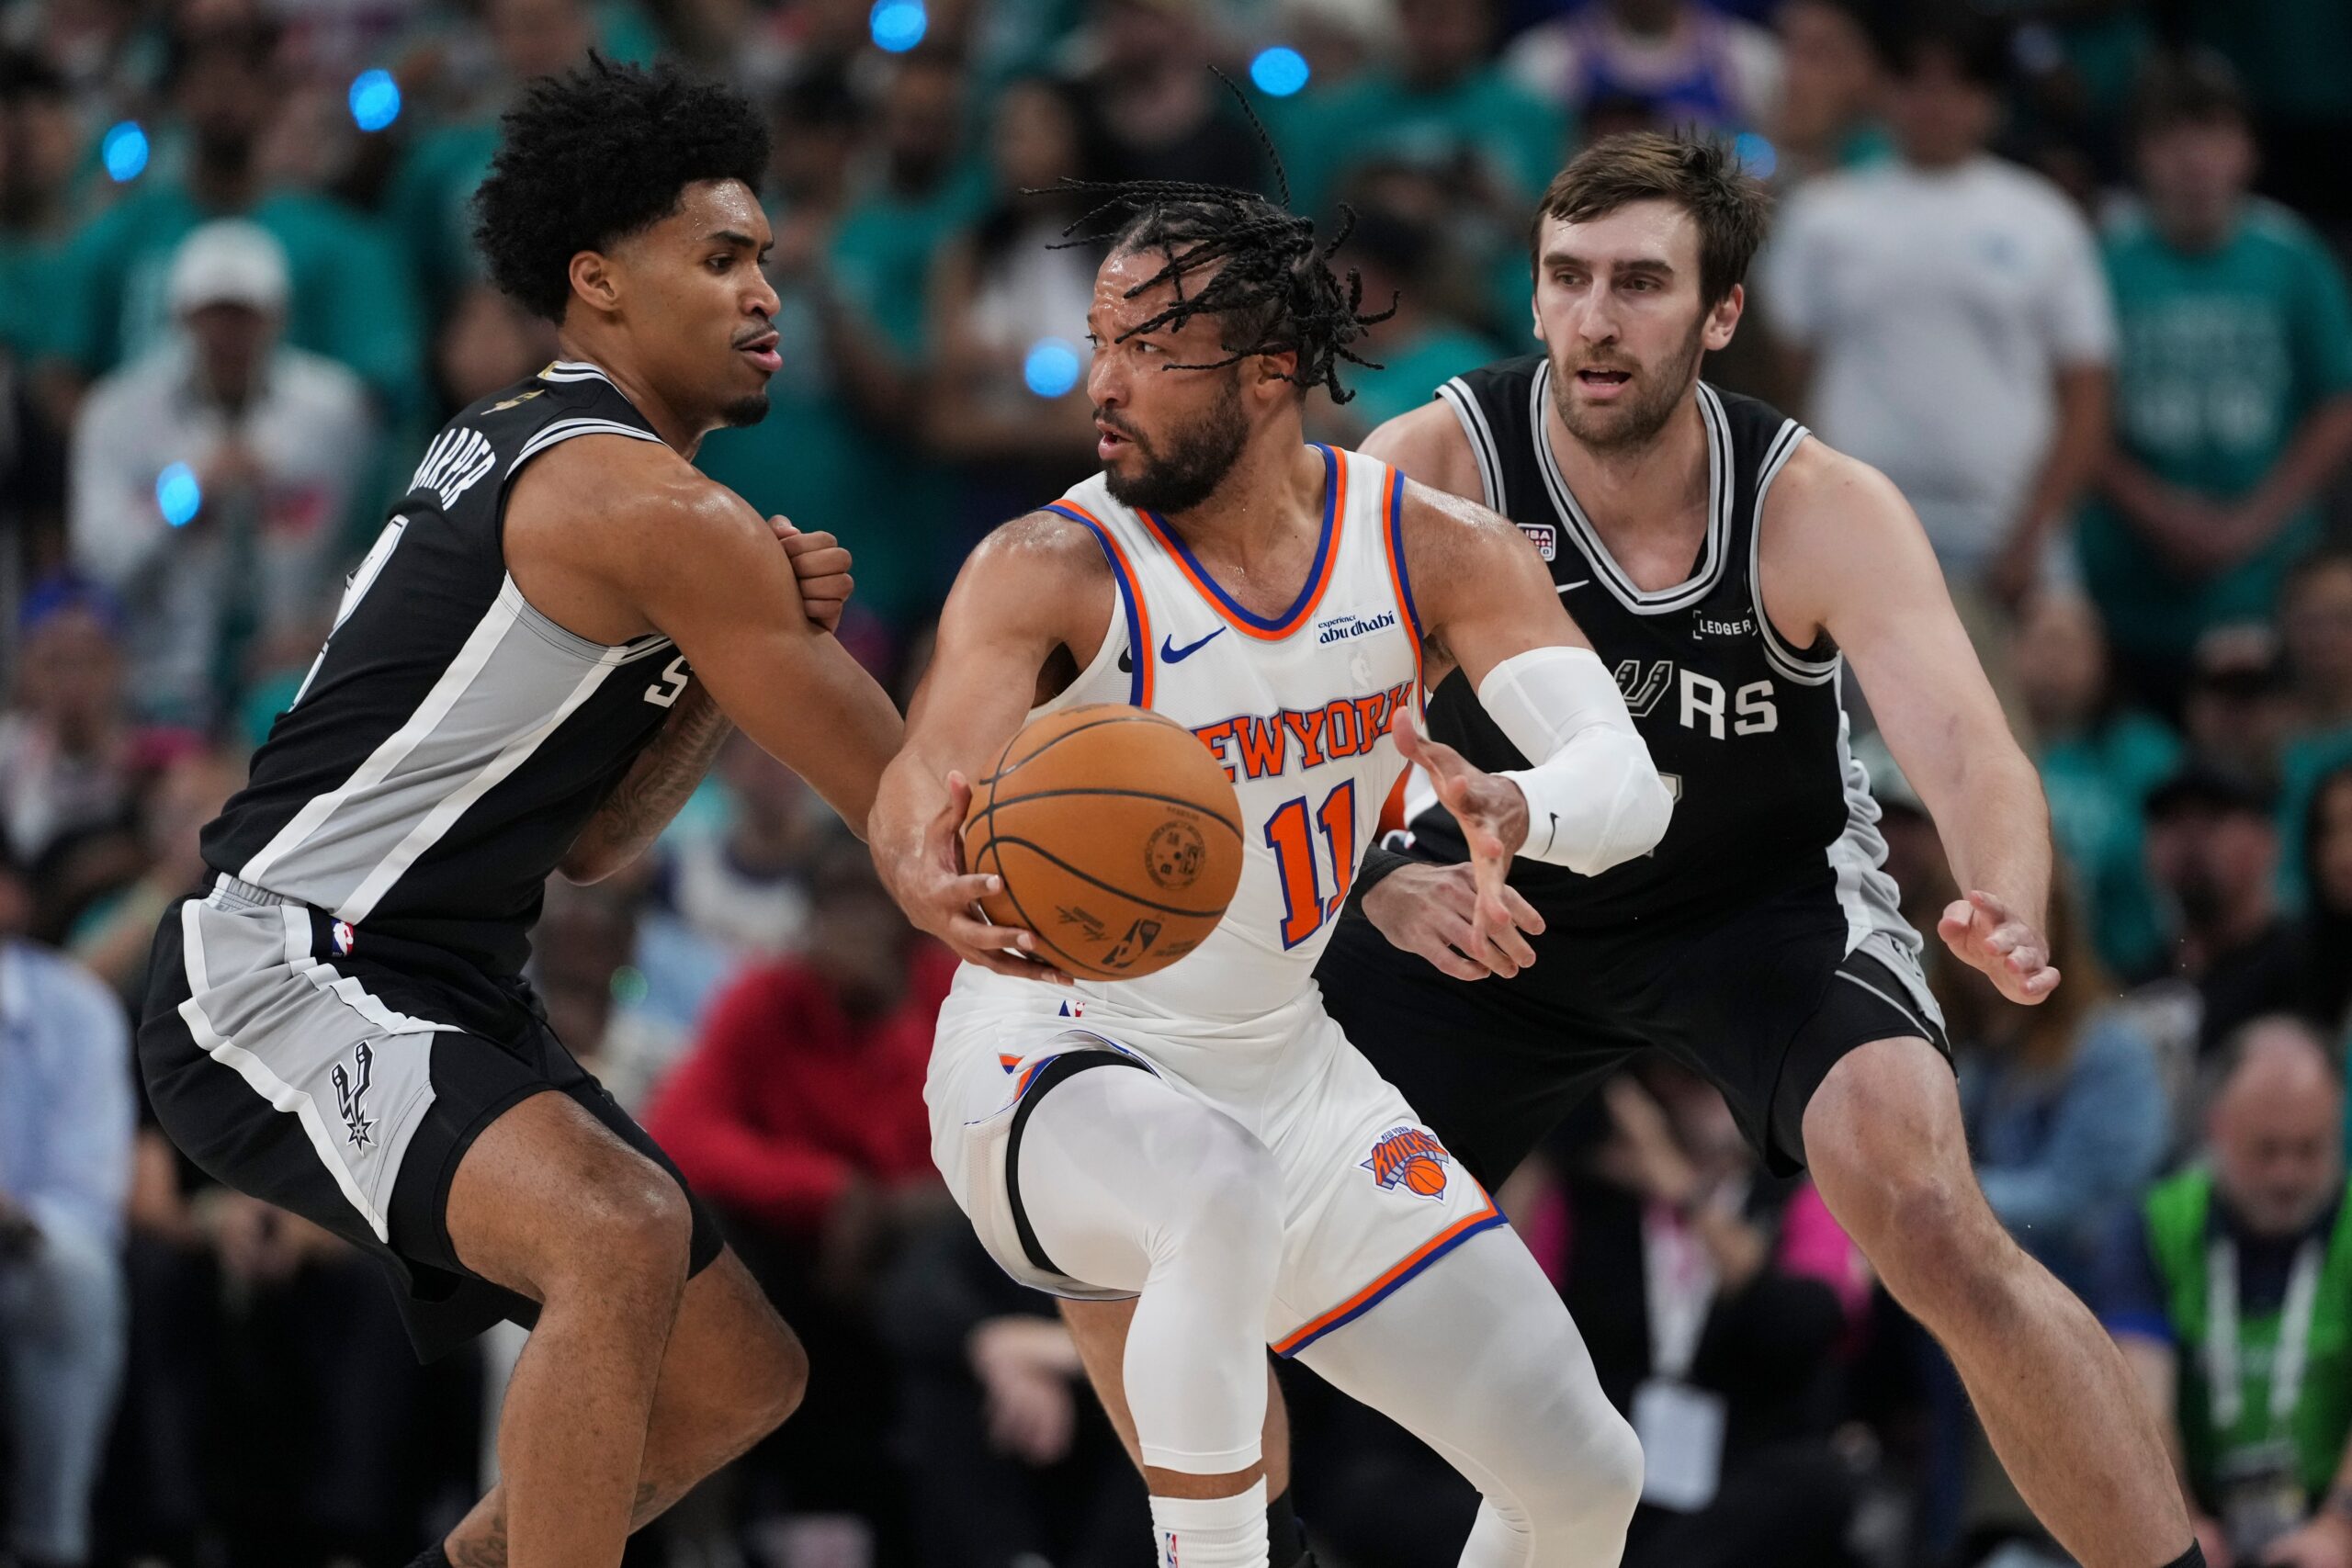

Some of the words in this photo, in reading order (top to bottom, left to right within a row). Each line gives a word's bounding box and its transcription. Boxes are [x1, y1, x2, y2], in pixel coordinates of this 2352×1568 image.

[1319, 627, 1349, 644] abu
[1350, 610, 1395, 637] dhabi
[1700, 619, 1751, 636] LEDGER
[1612, 660, 1778, 740] URS
[1263, 777, 1356, 952] 11
[1371, 1128, 1449, 1187] KNICKS
